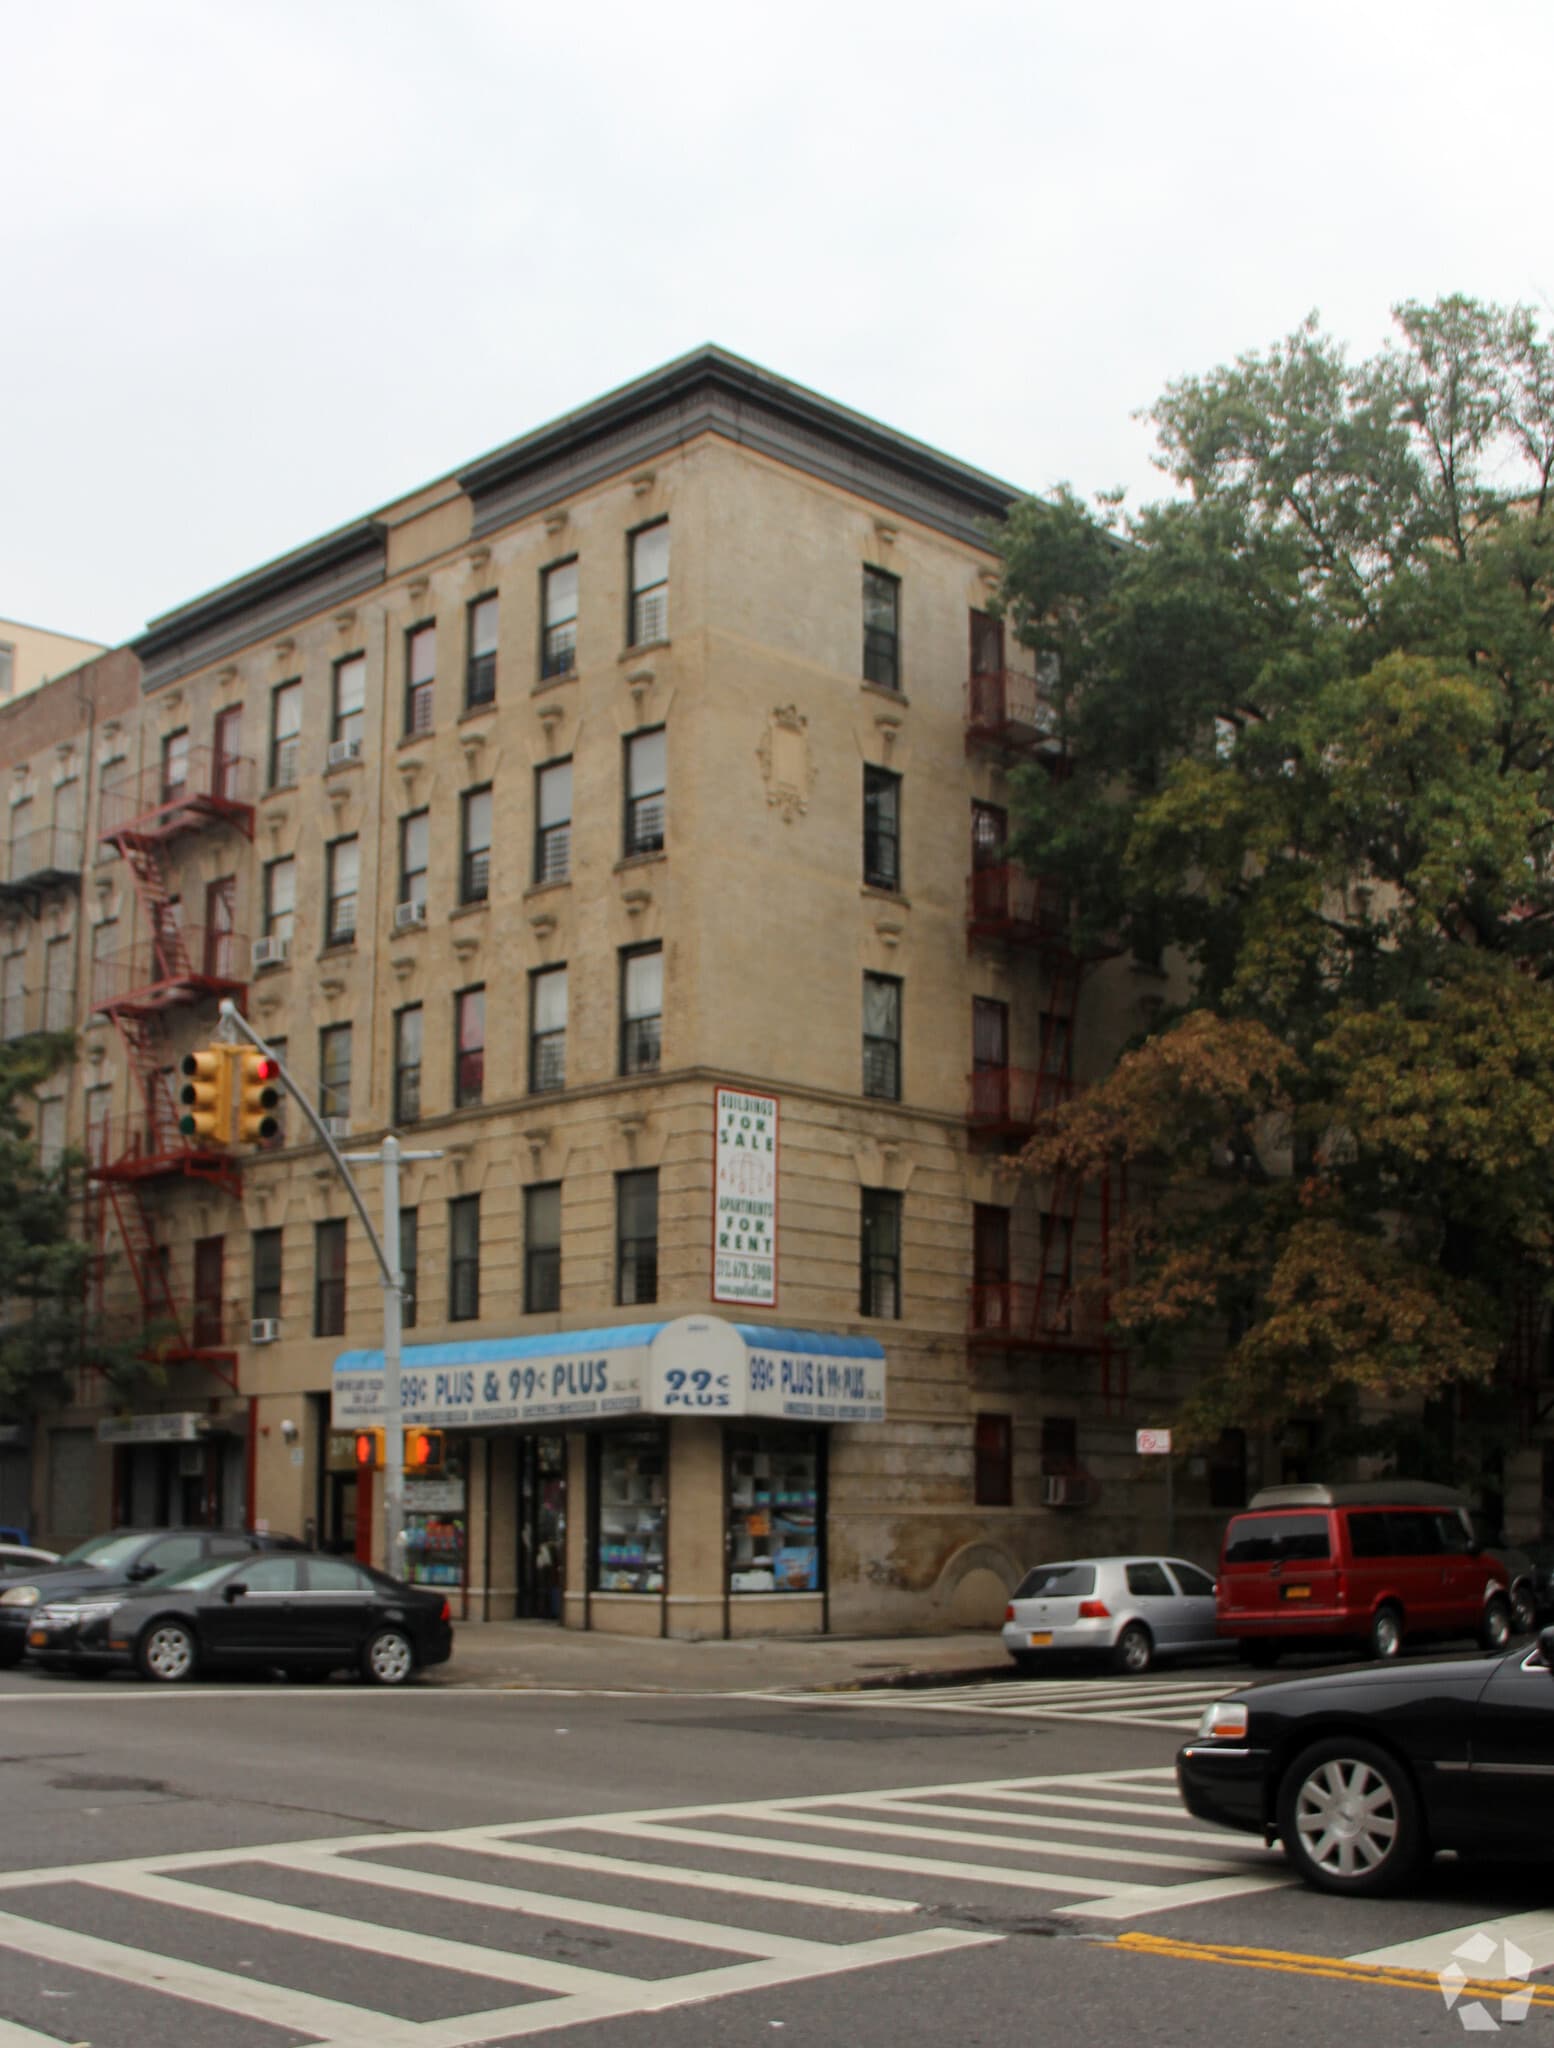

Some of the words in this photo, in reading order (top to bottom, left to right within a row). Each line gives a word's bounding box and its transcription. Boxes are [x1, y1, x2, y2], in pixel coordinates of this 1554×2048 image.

[720, 1092, 773, 1116] BUILDINGS
[727, 1113, 766, 1132] FOR
[720, 1128, 773, 1152] SALE
[719, 1196, 773, 1217] APARTMENTS
[726, 1214, 765, 1233] FOR
[719, 1231, 772, 1253] RENT
[434, 1370, 475, 1405] PLUS
[484, 1371, 500, 1402] &
[552, 1359, 609, 1397] PLUS
[780, 1359, 814, 1396] PLUS
[664, 1392, 731, 1406] PLUS
